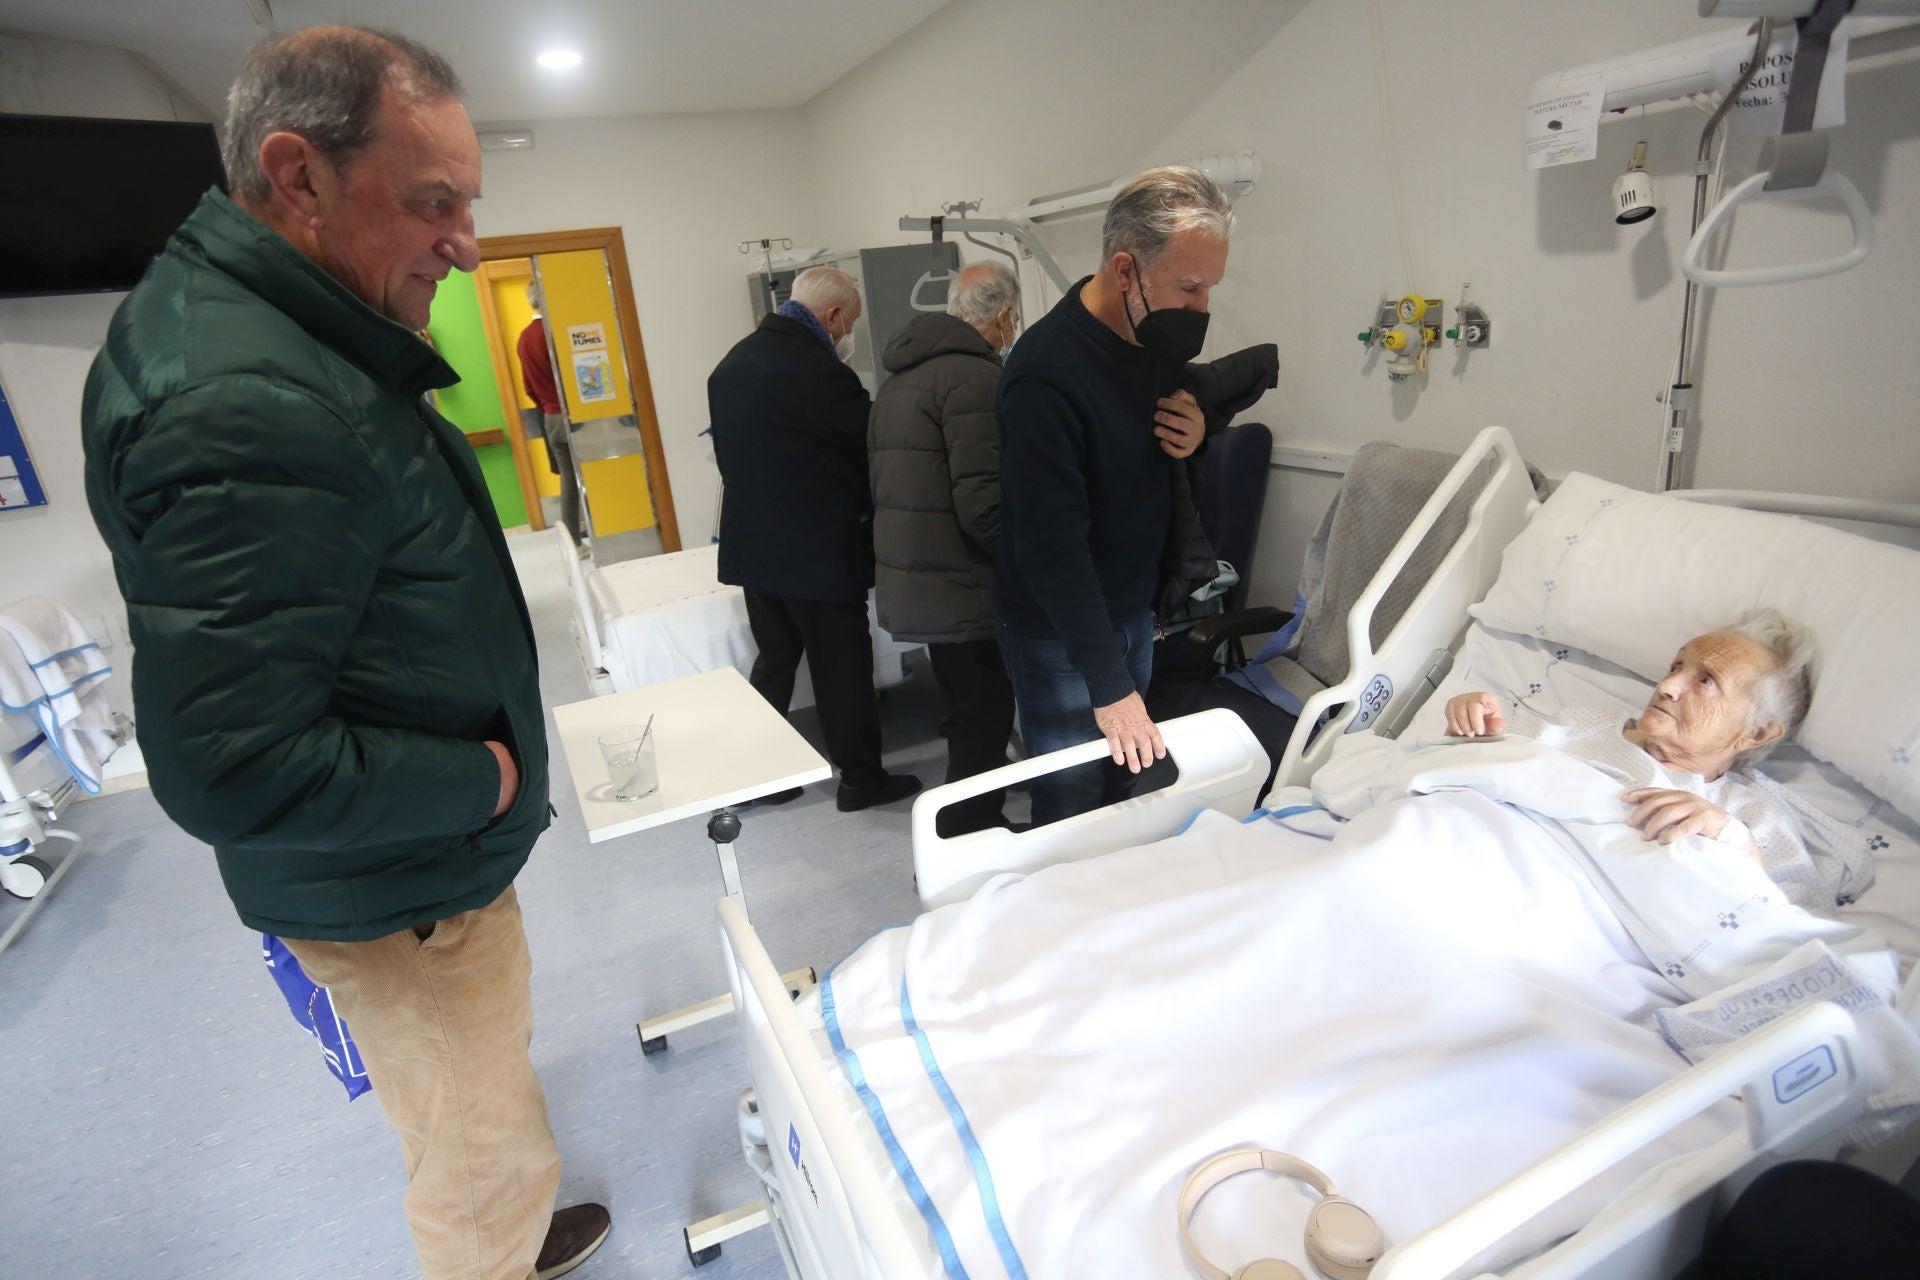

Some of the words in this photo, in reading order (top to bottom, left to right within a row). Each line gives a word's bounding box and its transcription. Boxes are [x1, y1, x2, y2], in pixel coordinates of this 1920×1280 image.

[1739, 52, 1793, 75] RPOS
[572, 331, 586, 340] NO
[573, 336, 602, 346] FUMES
